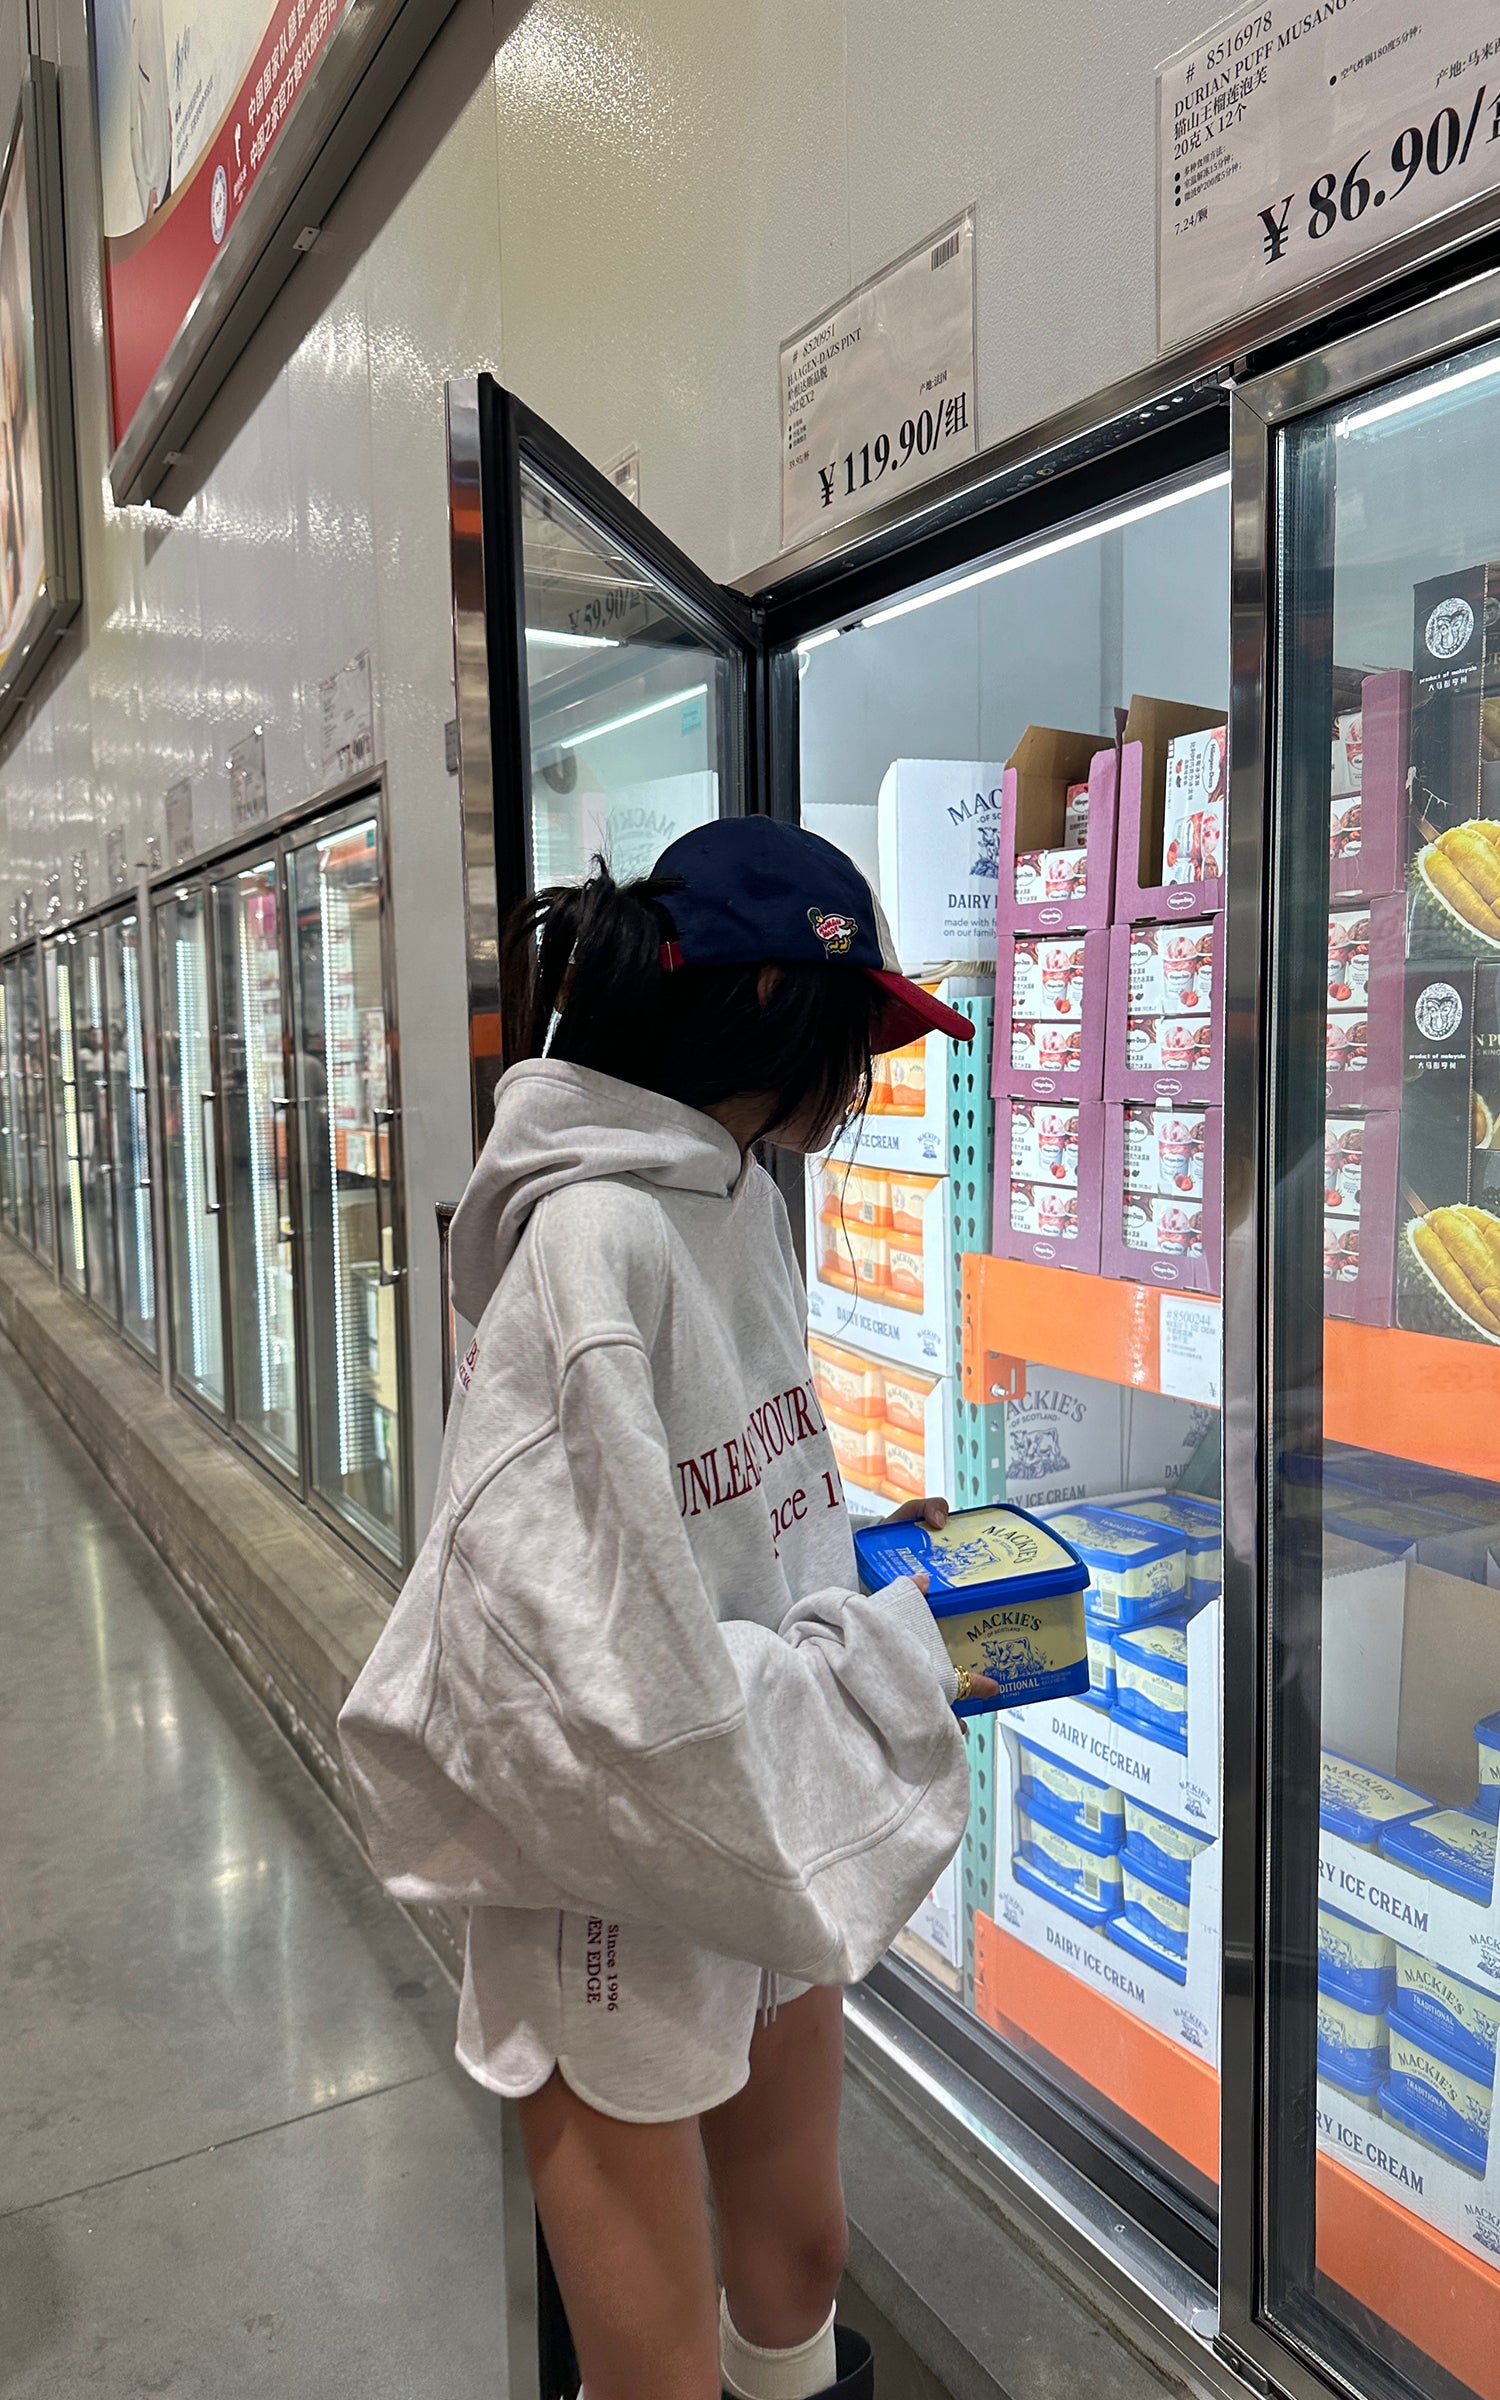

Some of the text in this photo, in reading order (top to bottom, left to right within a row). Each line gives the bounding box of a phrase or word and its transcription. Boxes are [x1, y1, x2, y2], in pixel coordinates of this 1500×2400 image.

[1185, 10, 1273, 84] # 8516978
[1173, 65, 1268, 142] 猫山王榴莲泡芙
[1174, 68, 1232, 119] DURIAN
[1234, 40, 1274, 80] PUFF
[1174, 103, 1247, 160] 20克 X 12个
[1257, 194, 1295, 265] ¥
[787, 328, 862, 387] HAAGEN-DAZS PINT
[817, 462, 837, 508] ¥
[844, 391, 969, 497] 119.90/组
[979, 815, 990, 824] OF
[944, 917, 969, 928] made
[970, 917, 990, 927] with
[948, 893, 991, 909] DAIRY
[943, 929, 955, 937] on
[956, 929, 972, 937] our
[871, 1135, 900, 1150] CREAM
[749, 1385, 819, 1465] YOUR
[1010, 1412, 1058, 1428] OF SCOTLAND
[821, 1471, 847, 1509] 1
[1028, 1491, 1045, 1507] ICE
[1046, 1484, 1086, 1505] CREAM
[966, 1611, 1042, 1643] MACKIE'S
[1052, 1717, 1088, 1749] DAIRY
[1340, 1870, 1365, 1900] ICE
[1369, 1886, 1429, 1932] CREAM
[587, 1951, 602, 2004] EDGE
[607, 1924, 619, 2012] Since 1996
[1046, 1925, 1145, 2004] DAIRY ICE CREAM
[1404, 1968, 1465, 2015] MACKIE'S
[1412, 1993, 1455, 2027] TRADITIONAL
[1397, 2052, 1458, 2101] MACKIE'S
[1406, 2077, 1448, 2112] TRADITIONAL
[1337, 2124, 1363, 2156] ICE
[1367, 2142, 1425, 2196] CREAM
